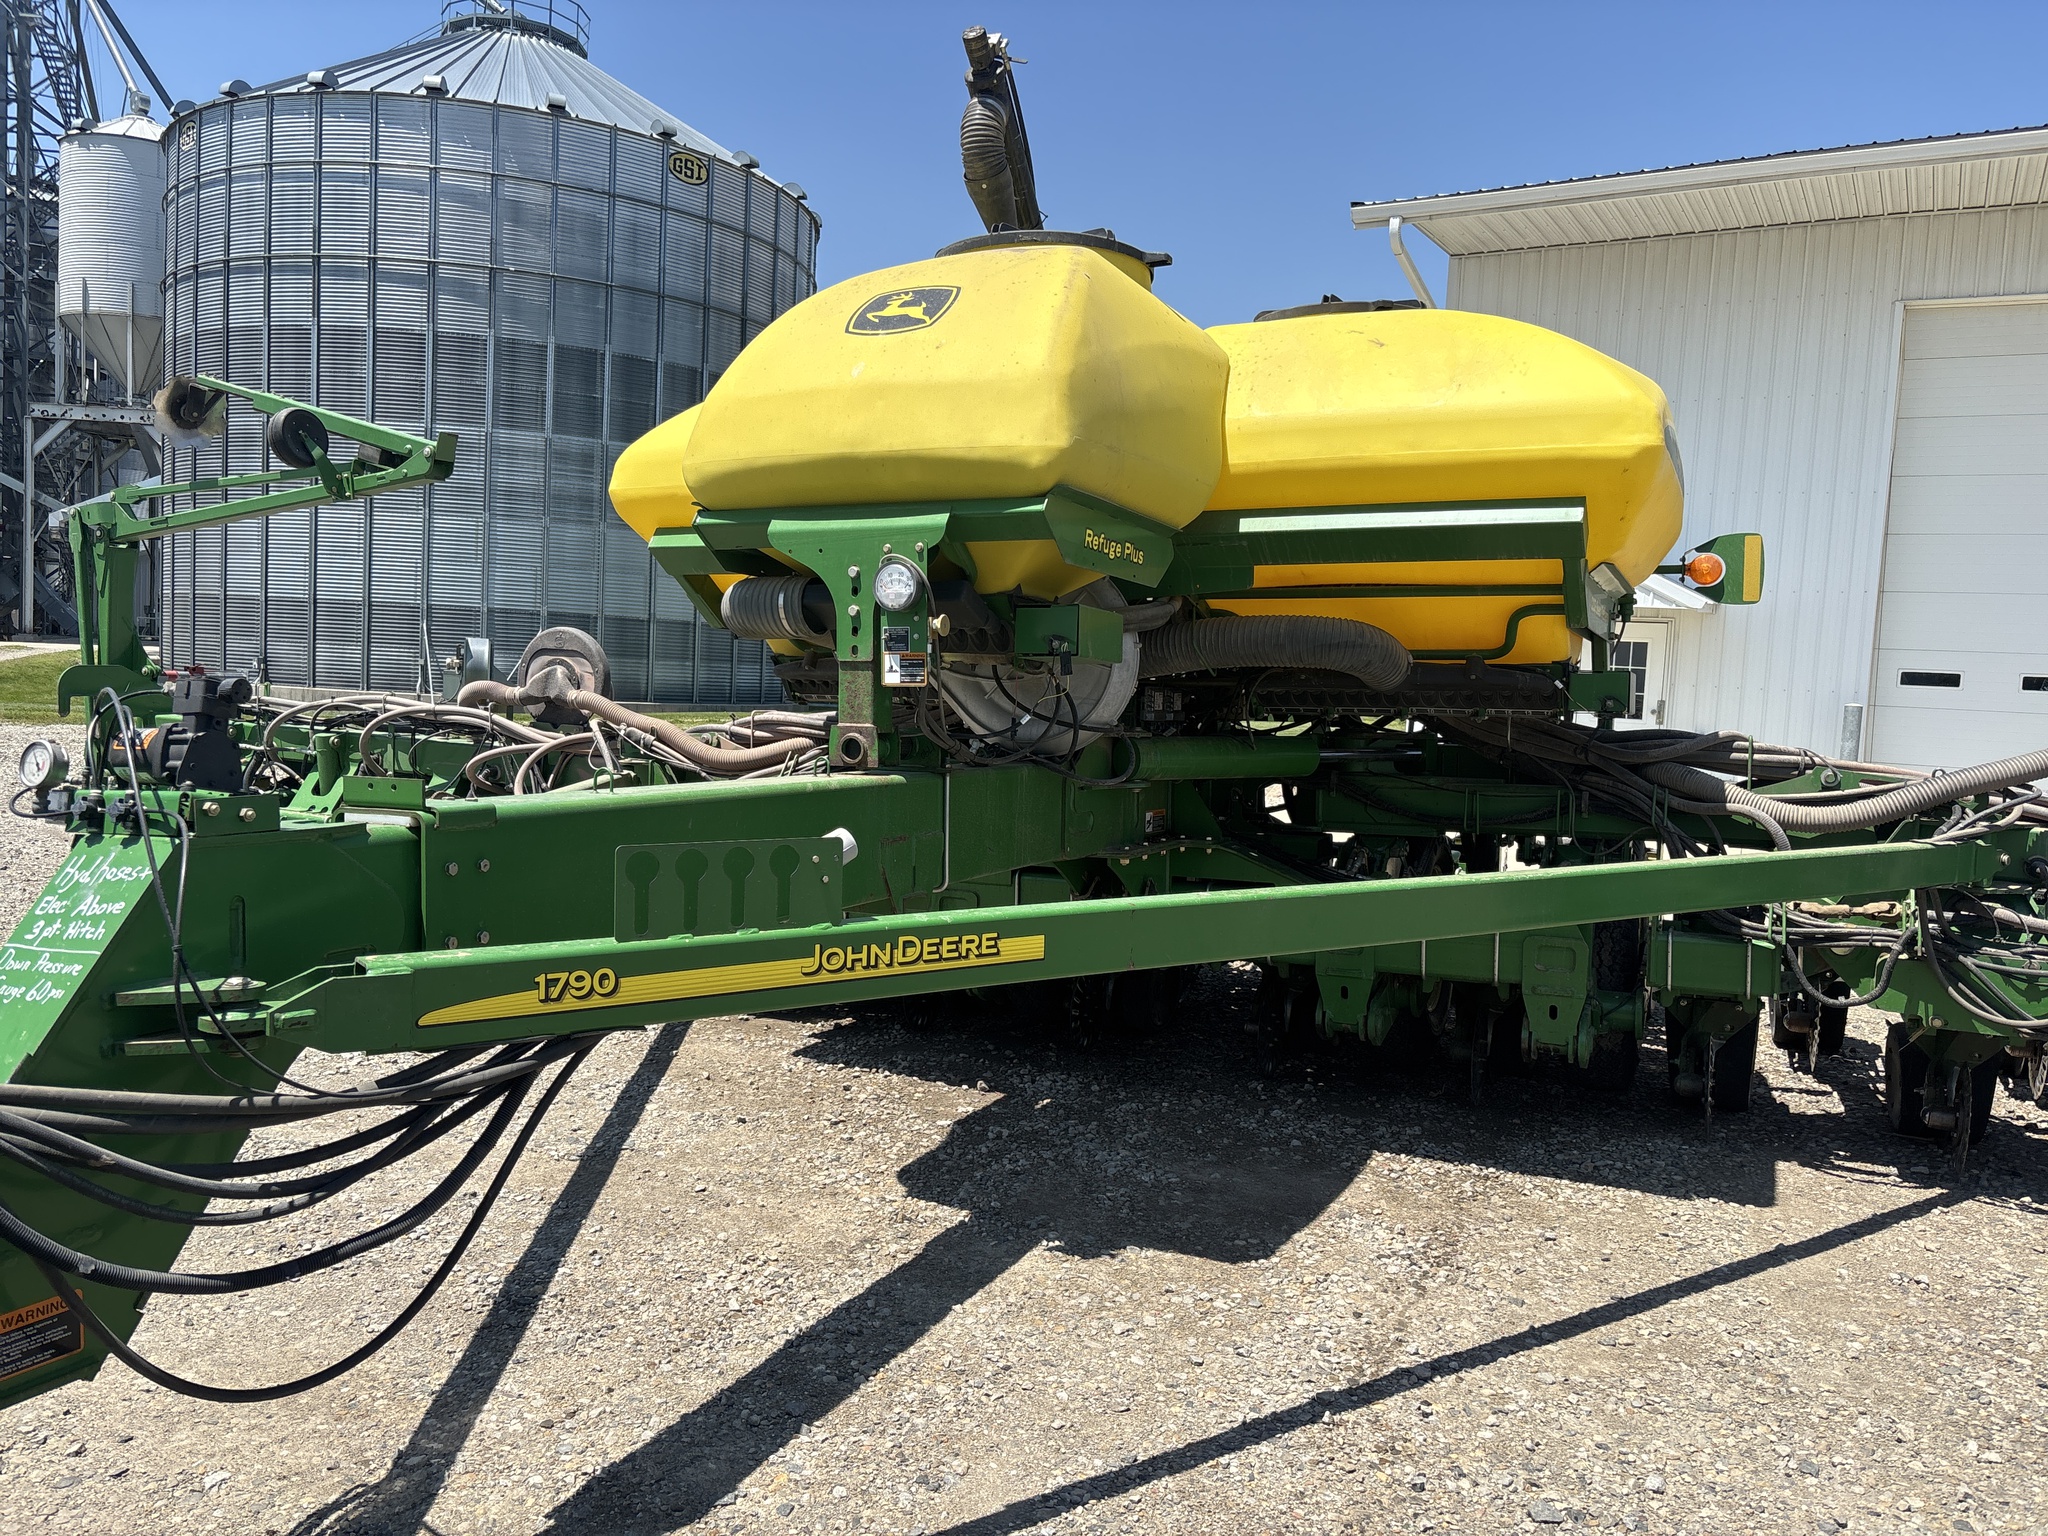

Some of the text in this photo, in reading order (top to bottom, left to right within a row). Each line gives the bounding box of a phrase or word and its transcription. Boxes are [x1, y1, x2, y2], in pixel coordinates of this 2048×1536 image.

[672, 157, 703, 181] GSI
[1084, 528, 1144, 564] Refuge Plus
[71, 895, 126, 917] Above
[63, 920, 106, 940] Hitch
[0, 948, 84, 976] Down Pressure
[801, 931, 1000, 976] JOHN DEERE
[0, 975, 26, 1004] auge
[534, 967, 618, 1002] 1790
